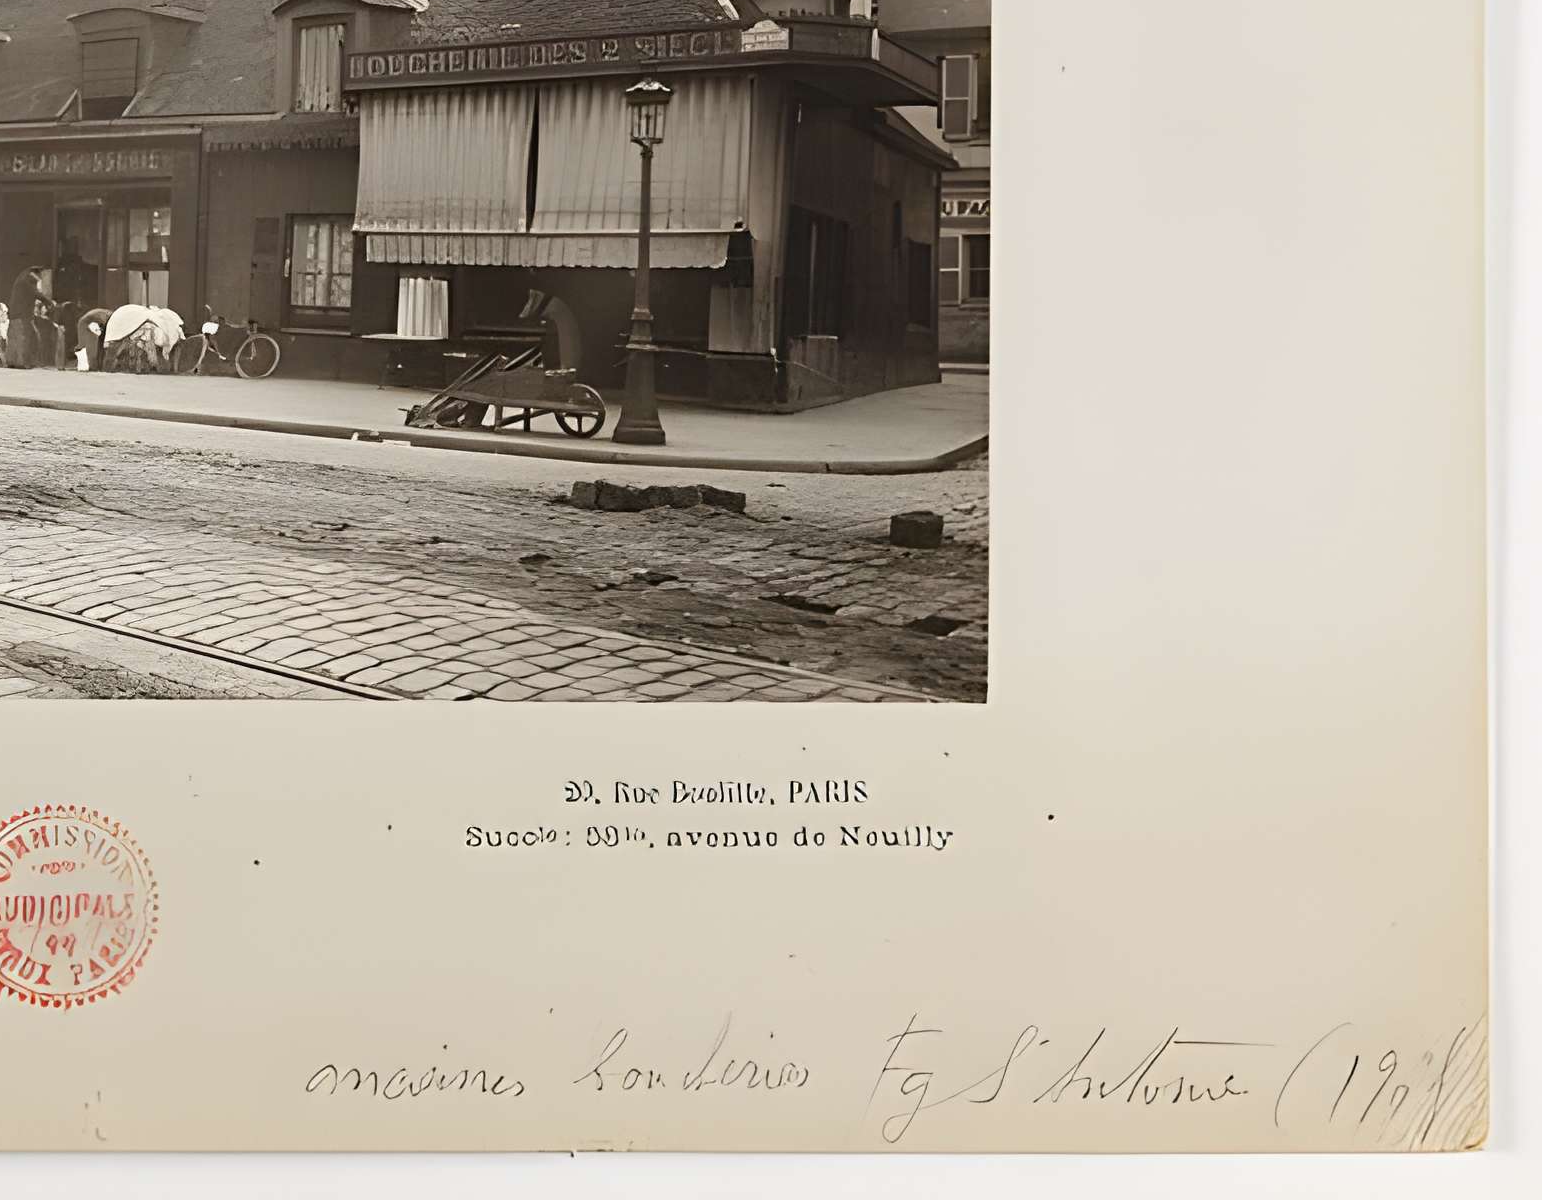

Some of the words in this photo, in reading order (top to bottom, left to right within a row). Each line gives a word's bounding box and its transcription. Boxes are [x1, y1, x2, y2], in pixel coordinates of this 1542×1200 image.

[789, 779, 869, 804] PARIS
[666, 831, 778, 847] avenue
[794, 825, 826, 847] de
[839, 825, 954, 851] Neuilly
